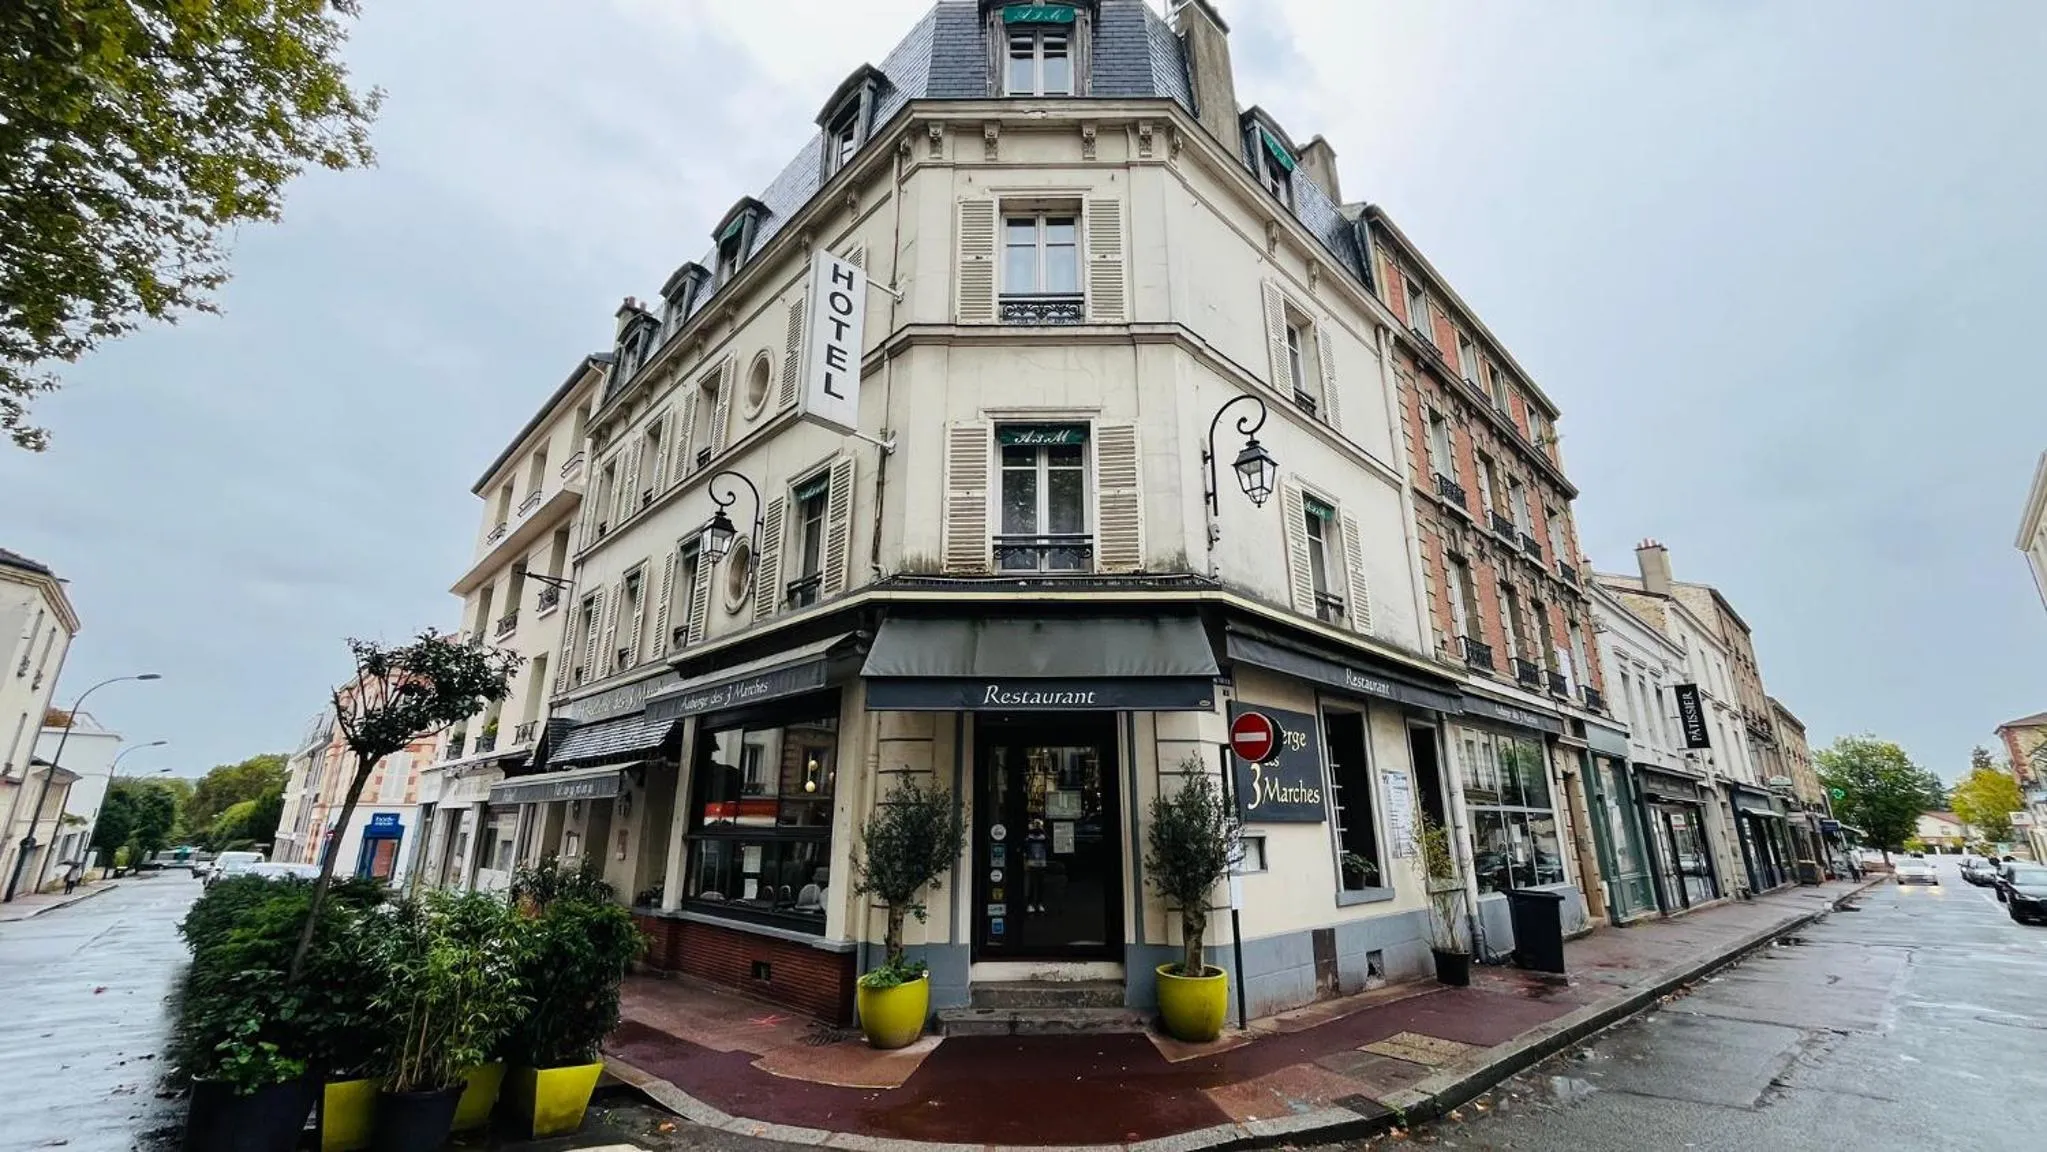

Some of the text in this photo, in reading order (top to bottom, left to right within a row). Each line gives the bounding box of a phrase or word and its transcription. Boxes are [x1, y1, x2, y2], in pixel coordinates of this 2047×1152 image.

[824, 263, 854, 401] HOTEL
[983, 684, 1097, 704] Restaurant
[1346, 667, 1390, 696] Restaurant
[1282, 729, 1307, 752] erge
[1247, 762, 1321, 810] 3 Marches
